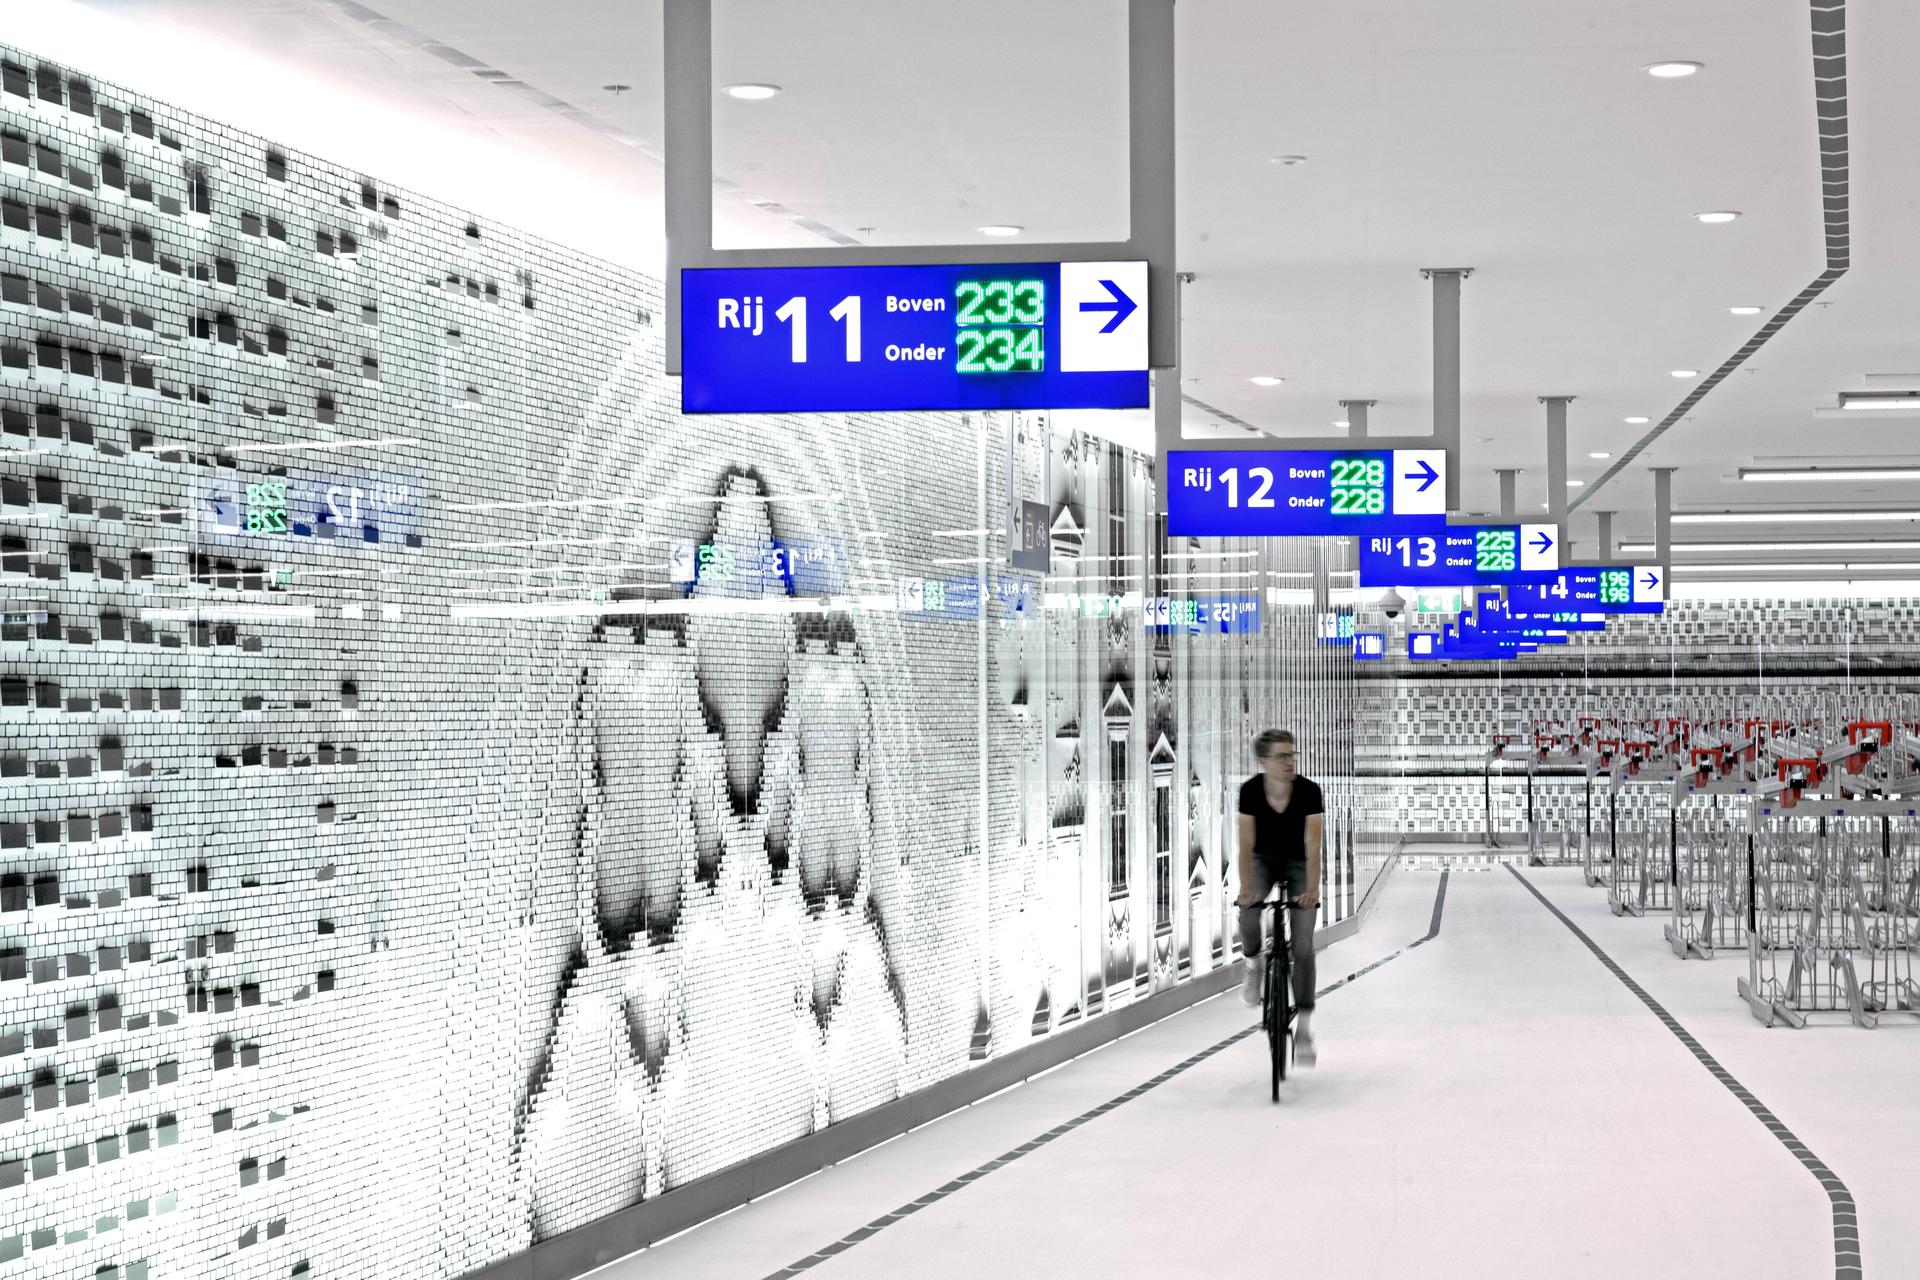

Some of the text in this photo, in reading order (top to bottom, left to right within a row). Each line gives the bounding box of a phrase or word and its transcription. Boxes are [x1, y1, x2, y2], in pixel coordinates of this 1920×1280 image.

[886, 279, 1045, 325] Boven 233
[718, 295, 862, 363] Rij 11
[884, 327, 1045, 374] Onder 234
[1184, 466, 1275, 508] Rij 12
[1289, 459, 1385, 487] Boven 228
[1288, 487, 1385, 515] Onder 228
[1371, 536, 1437, 567] Rij 13
[1446, 531, 1516, 551] Boven 225
[1445, 550, 1516, 571] Onder 226
[1575, 571, 1630, 587] Boven 196
[1485, 599, 1500, 612] Rij
[1575, 586, 1630, 603] Onder 196
